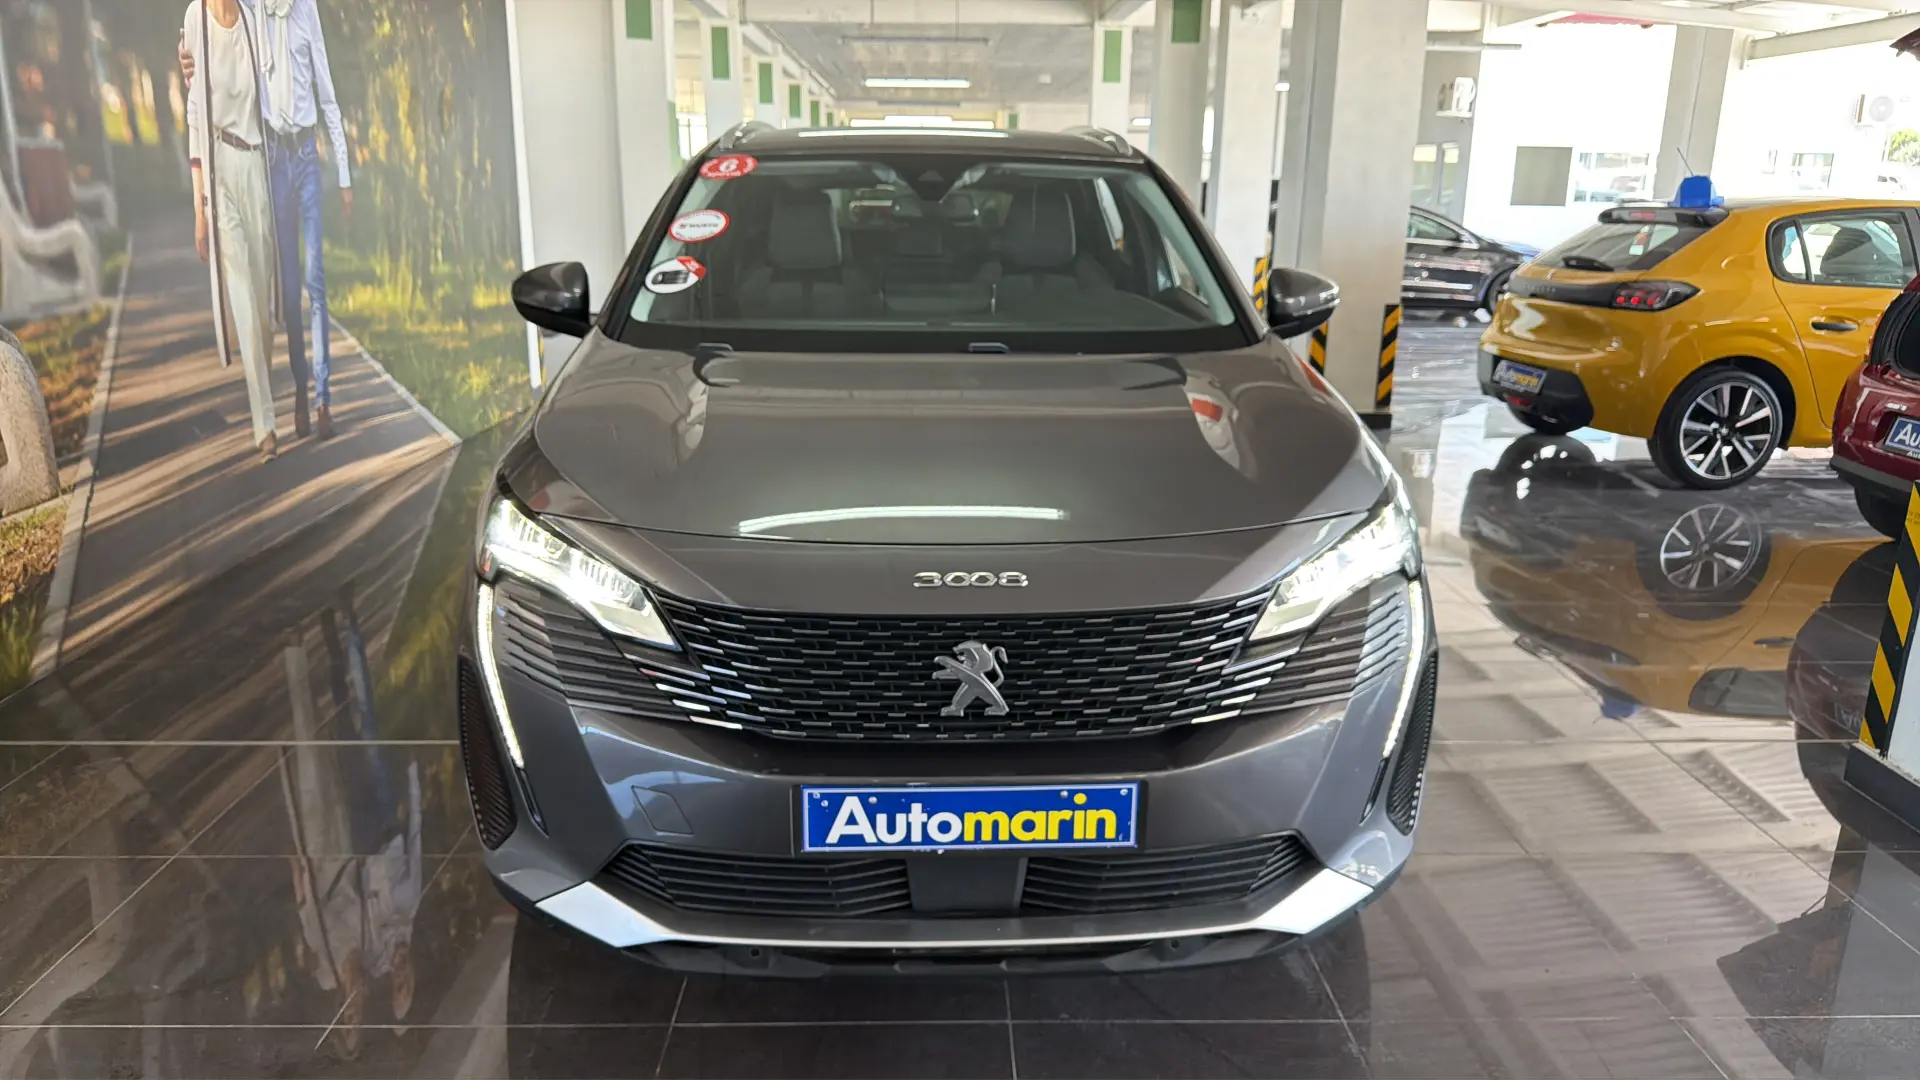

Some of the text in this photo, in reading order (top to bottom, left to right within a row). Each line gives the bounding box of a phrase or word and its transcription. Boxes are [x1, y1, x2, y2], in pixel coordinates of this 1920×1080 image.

[1893, 423, 1920, 448] Au
[913, 571, 1029, 588] 3008
[825, 793, 1117, 844] Automarin
